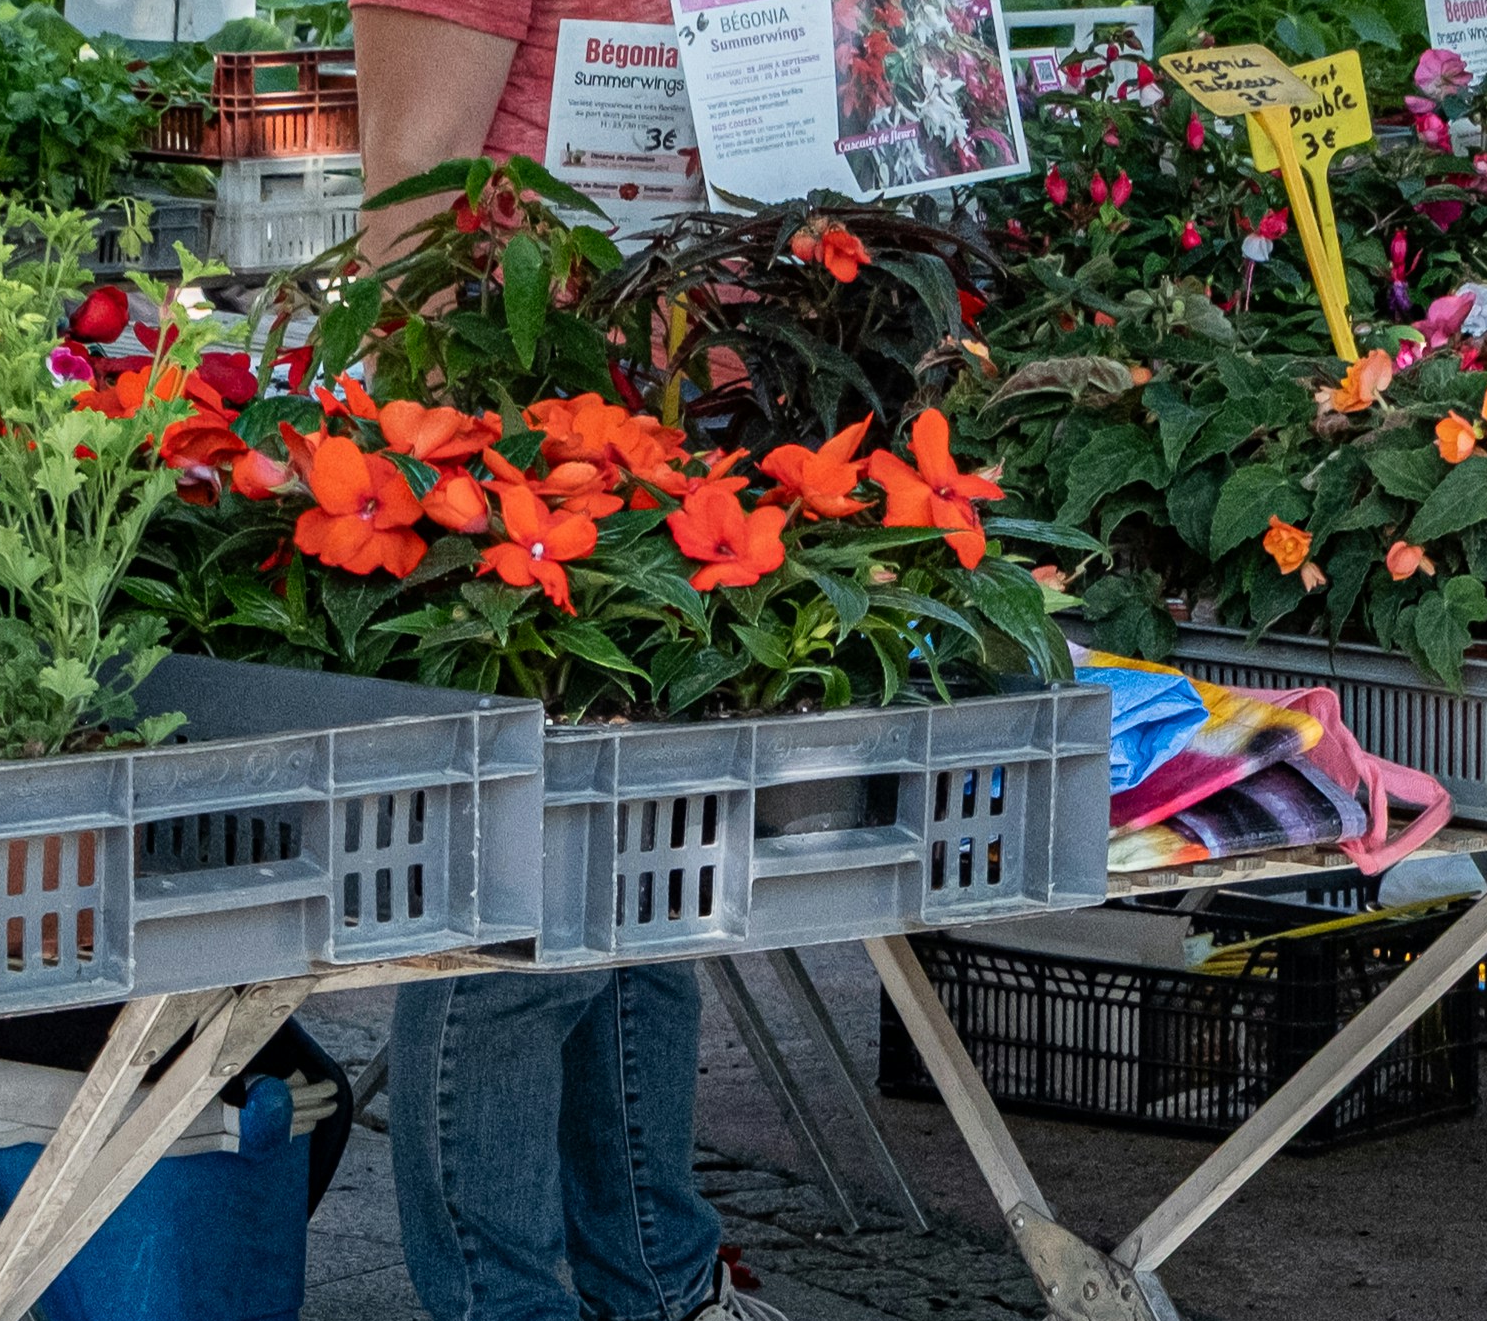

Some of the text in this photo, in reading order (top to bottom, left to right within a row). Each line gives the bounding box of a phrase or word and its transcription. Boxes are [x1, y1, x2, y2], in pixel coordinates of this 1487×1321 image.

[720, 6, 790, 34] BÉGONIA
[585, 37, 679, 69] Bégonia
[710, 26, 806, 53] Summerwings
[574, 71, 685, 98] Summerwings
[1290, 85, 1358, 128] Double
[838, 133, 876, 153] Cascade
[878, 131, 889, 145] de
[890, 127, 917, 145] fleurs
[1301, 132, 1320, 161] 3
